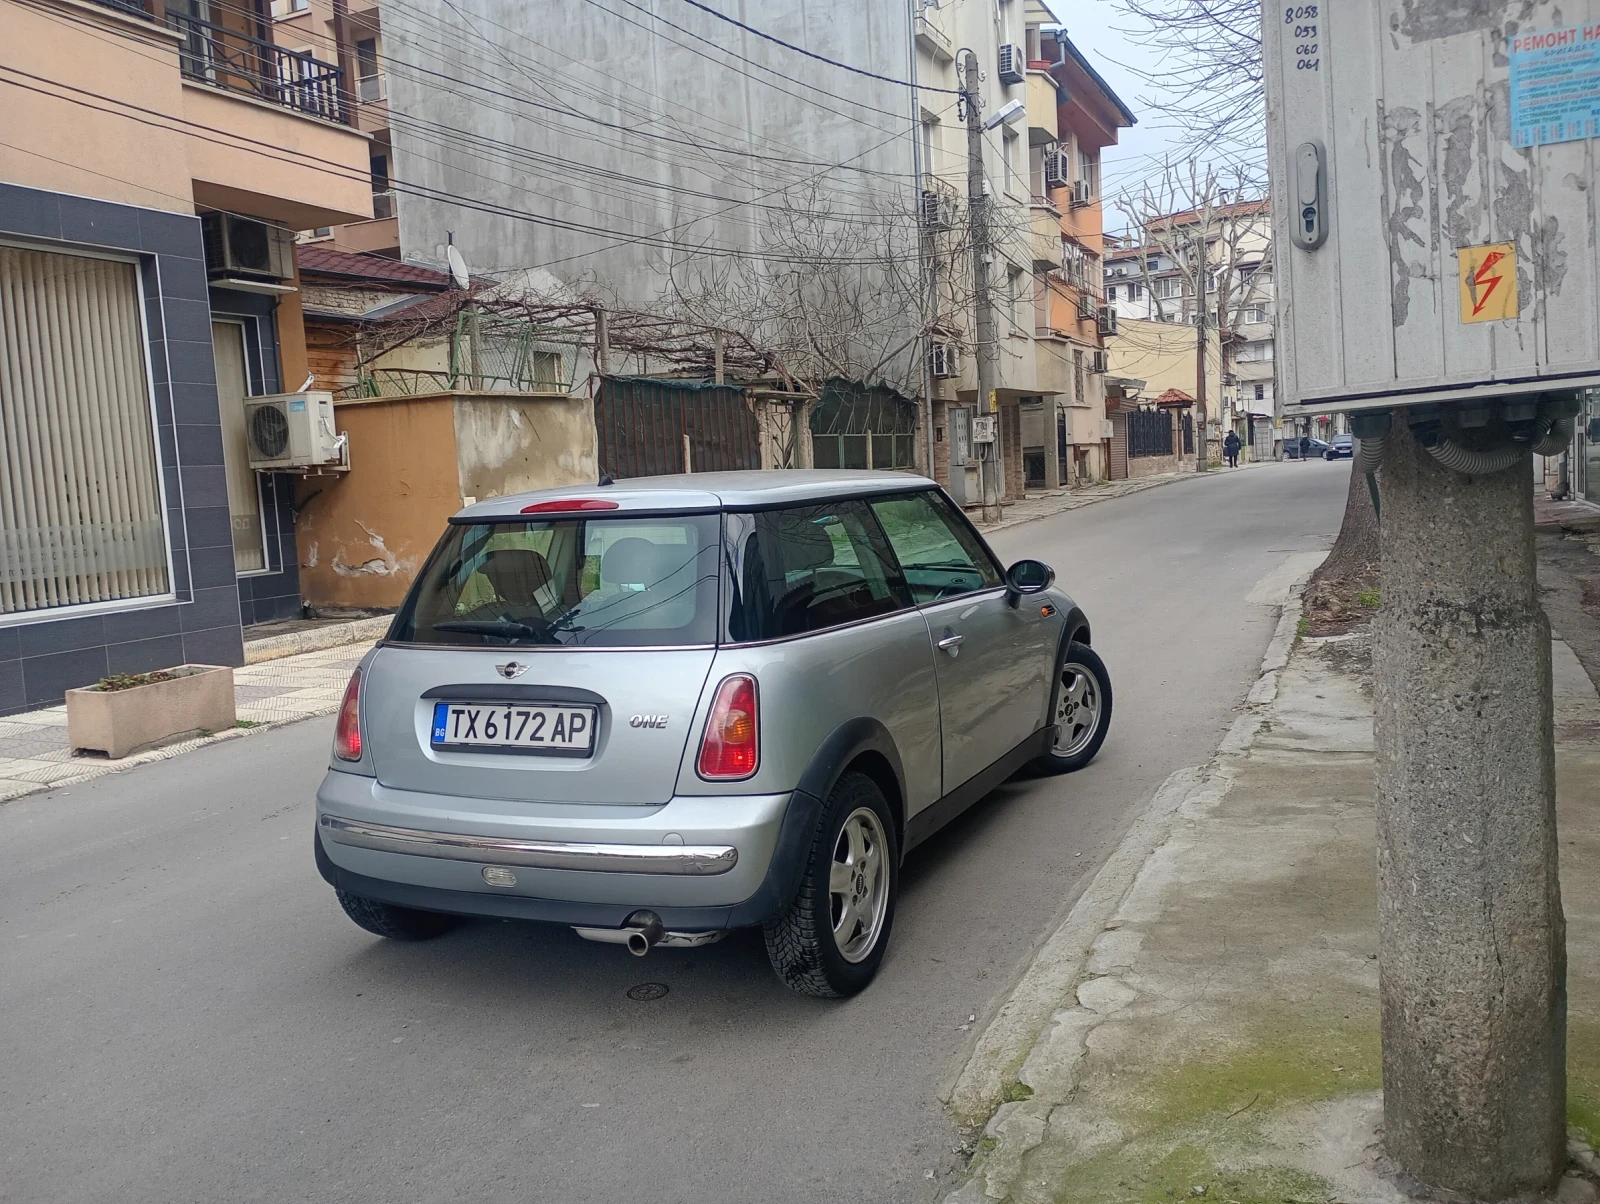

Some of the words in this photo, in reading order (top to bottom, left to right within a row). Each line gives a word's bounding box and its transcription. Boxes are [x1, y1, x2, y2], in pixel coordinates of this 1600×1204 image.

[1513, 28, 1577, 54] РЕМОНТ
[1296, 44, 1318, 55] 060
[1297, 58, 1320, 71] 061
[435, 728, 445, 737] BG
[451, 709, 587, 743] TX6172AP
[629, 714, 669, 729] ONE
